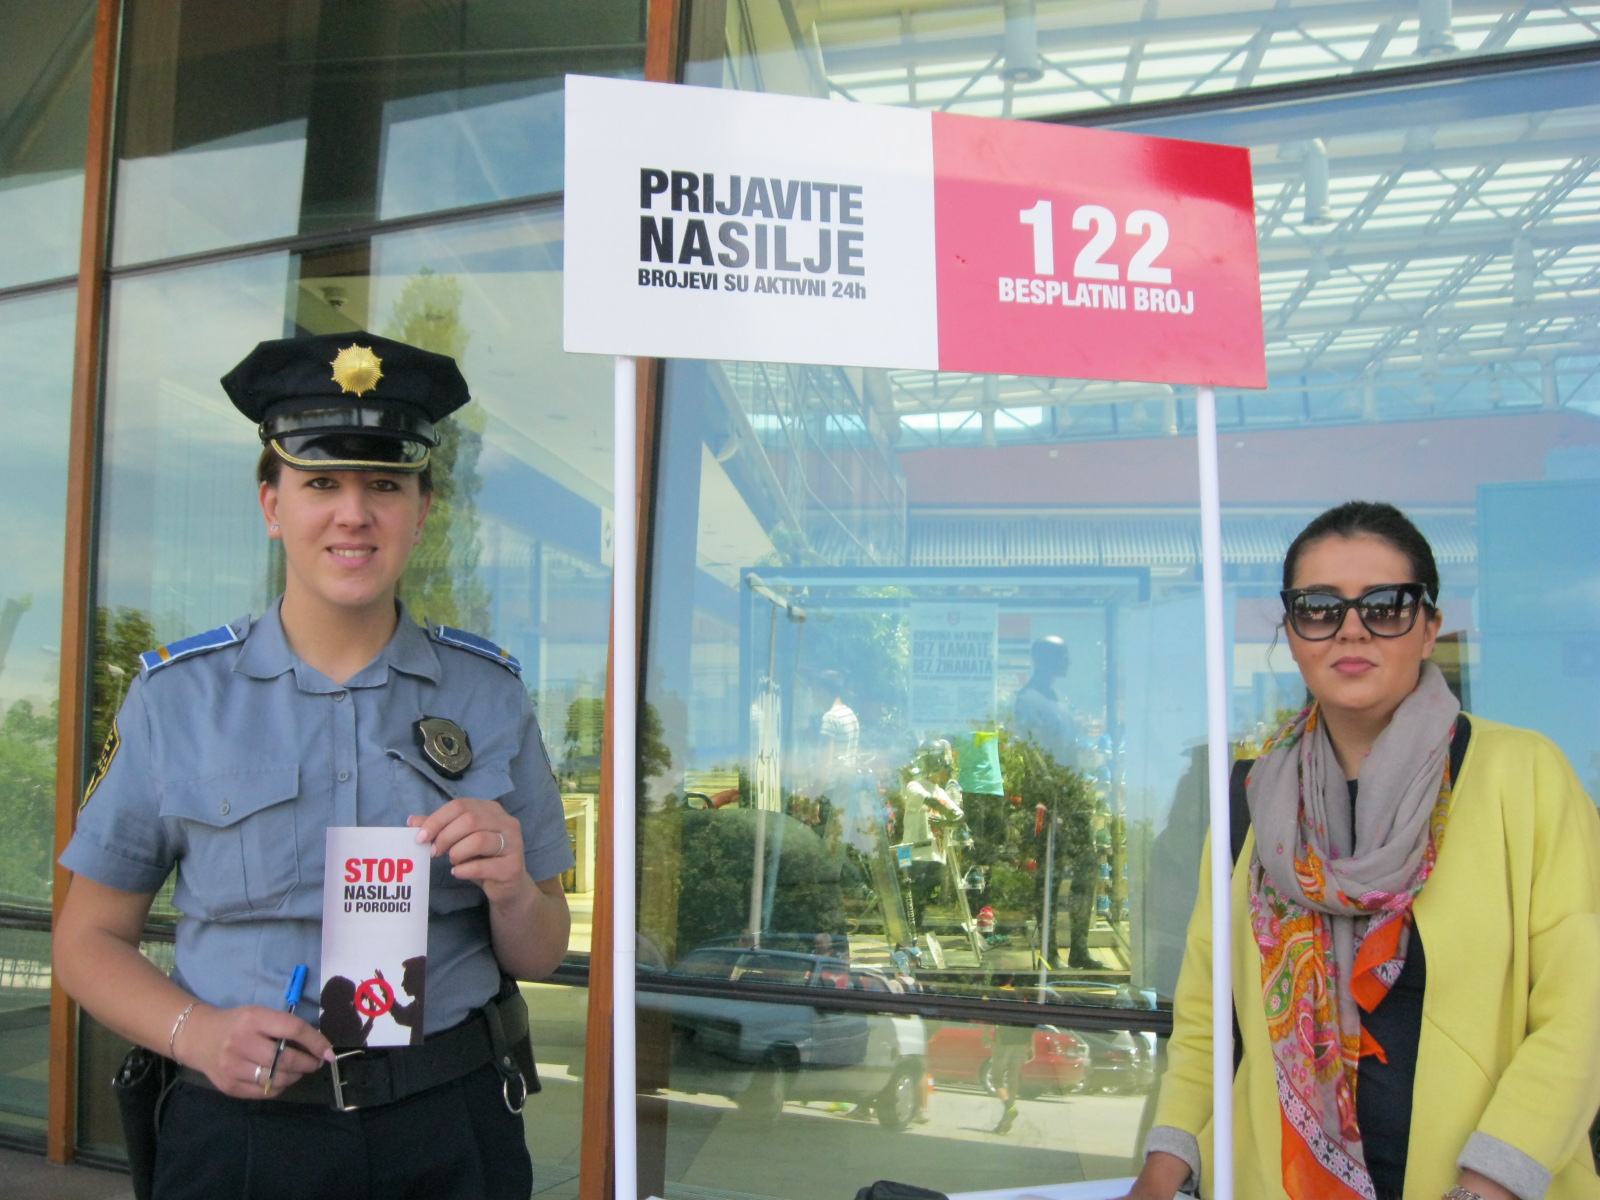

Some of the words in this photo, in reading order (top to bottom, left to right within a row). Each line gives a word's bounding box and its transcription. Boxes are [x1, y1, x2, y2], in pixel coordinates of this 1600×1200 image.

[640, 168, 863, 225] PRIJAVITE
[640, 215, 865, 276] NASILJE
[1019, 200, 1172, 284] 122
[638, 268, 718, 290] BROJEVI
[724, 273, 749, 293] SU
[754, 276, 826, 297] AKTIVNI
[831, 281, 866, 299] 24h
[999, 277, 1126, 309] BESPLATNI
[1134, 286, 1194, 314] BROJ
[344, 858, 413, 882] STOP
[344, 885, 411, 900] NASILJU
[344, 902, 352, 913] U
[356, 902, 411, 913] PORODICI
